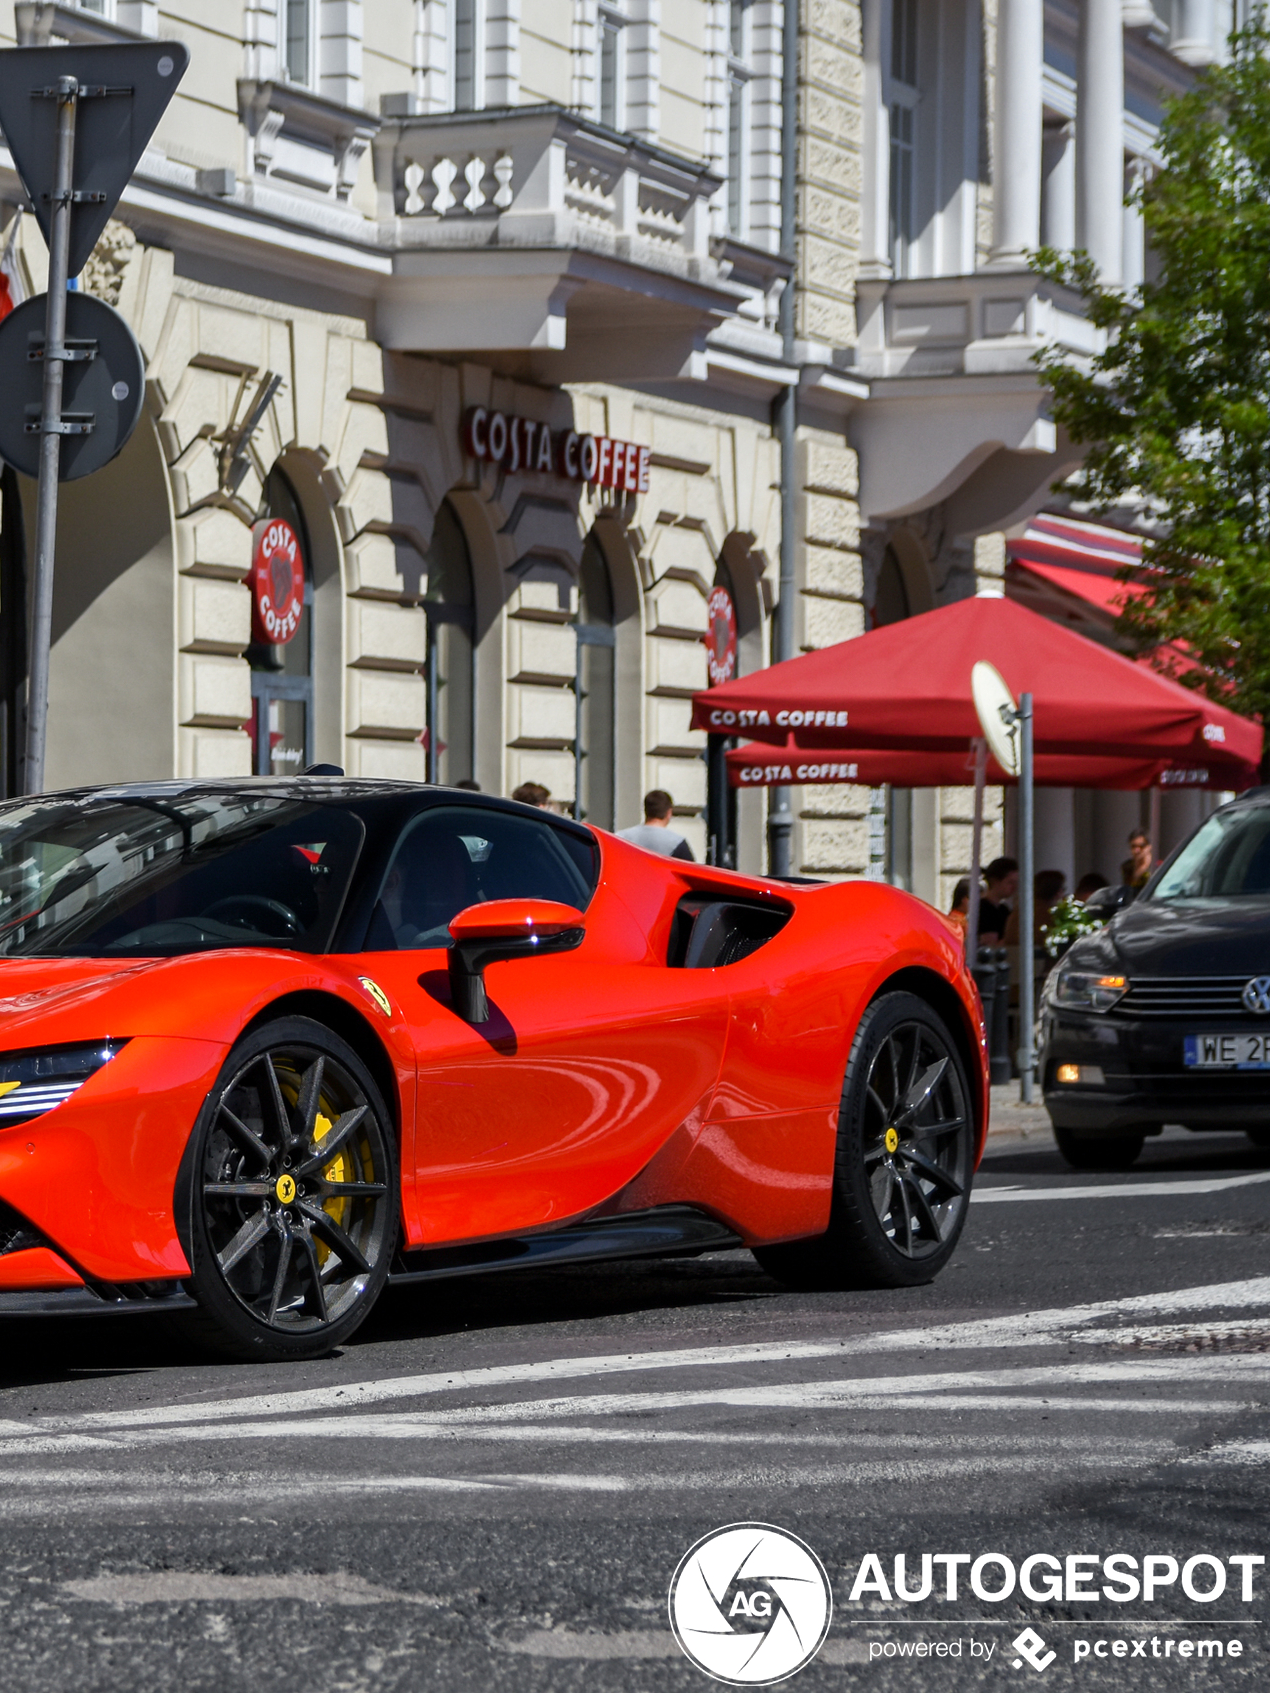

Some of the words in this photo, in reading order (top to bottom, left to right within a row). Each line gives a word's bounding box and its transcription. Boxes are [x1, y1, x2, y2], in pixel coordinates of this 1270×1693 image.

[472, 408, 552, 471] COSTA
[564, 432, 650, 492] COFFEE
[262, 524, 297, 563] COSTA
[260, 595, 301, 639] COFFEE
[710, 709, 770, 727] COSTA
[775, 710, 848, 727] COFFEE
[740, 765, 792, 782] COSTA
[796, 763, 858, 779] COFFEE
[1203, 1036, 1236, 1062] WE
